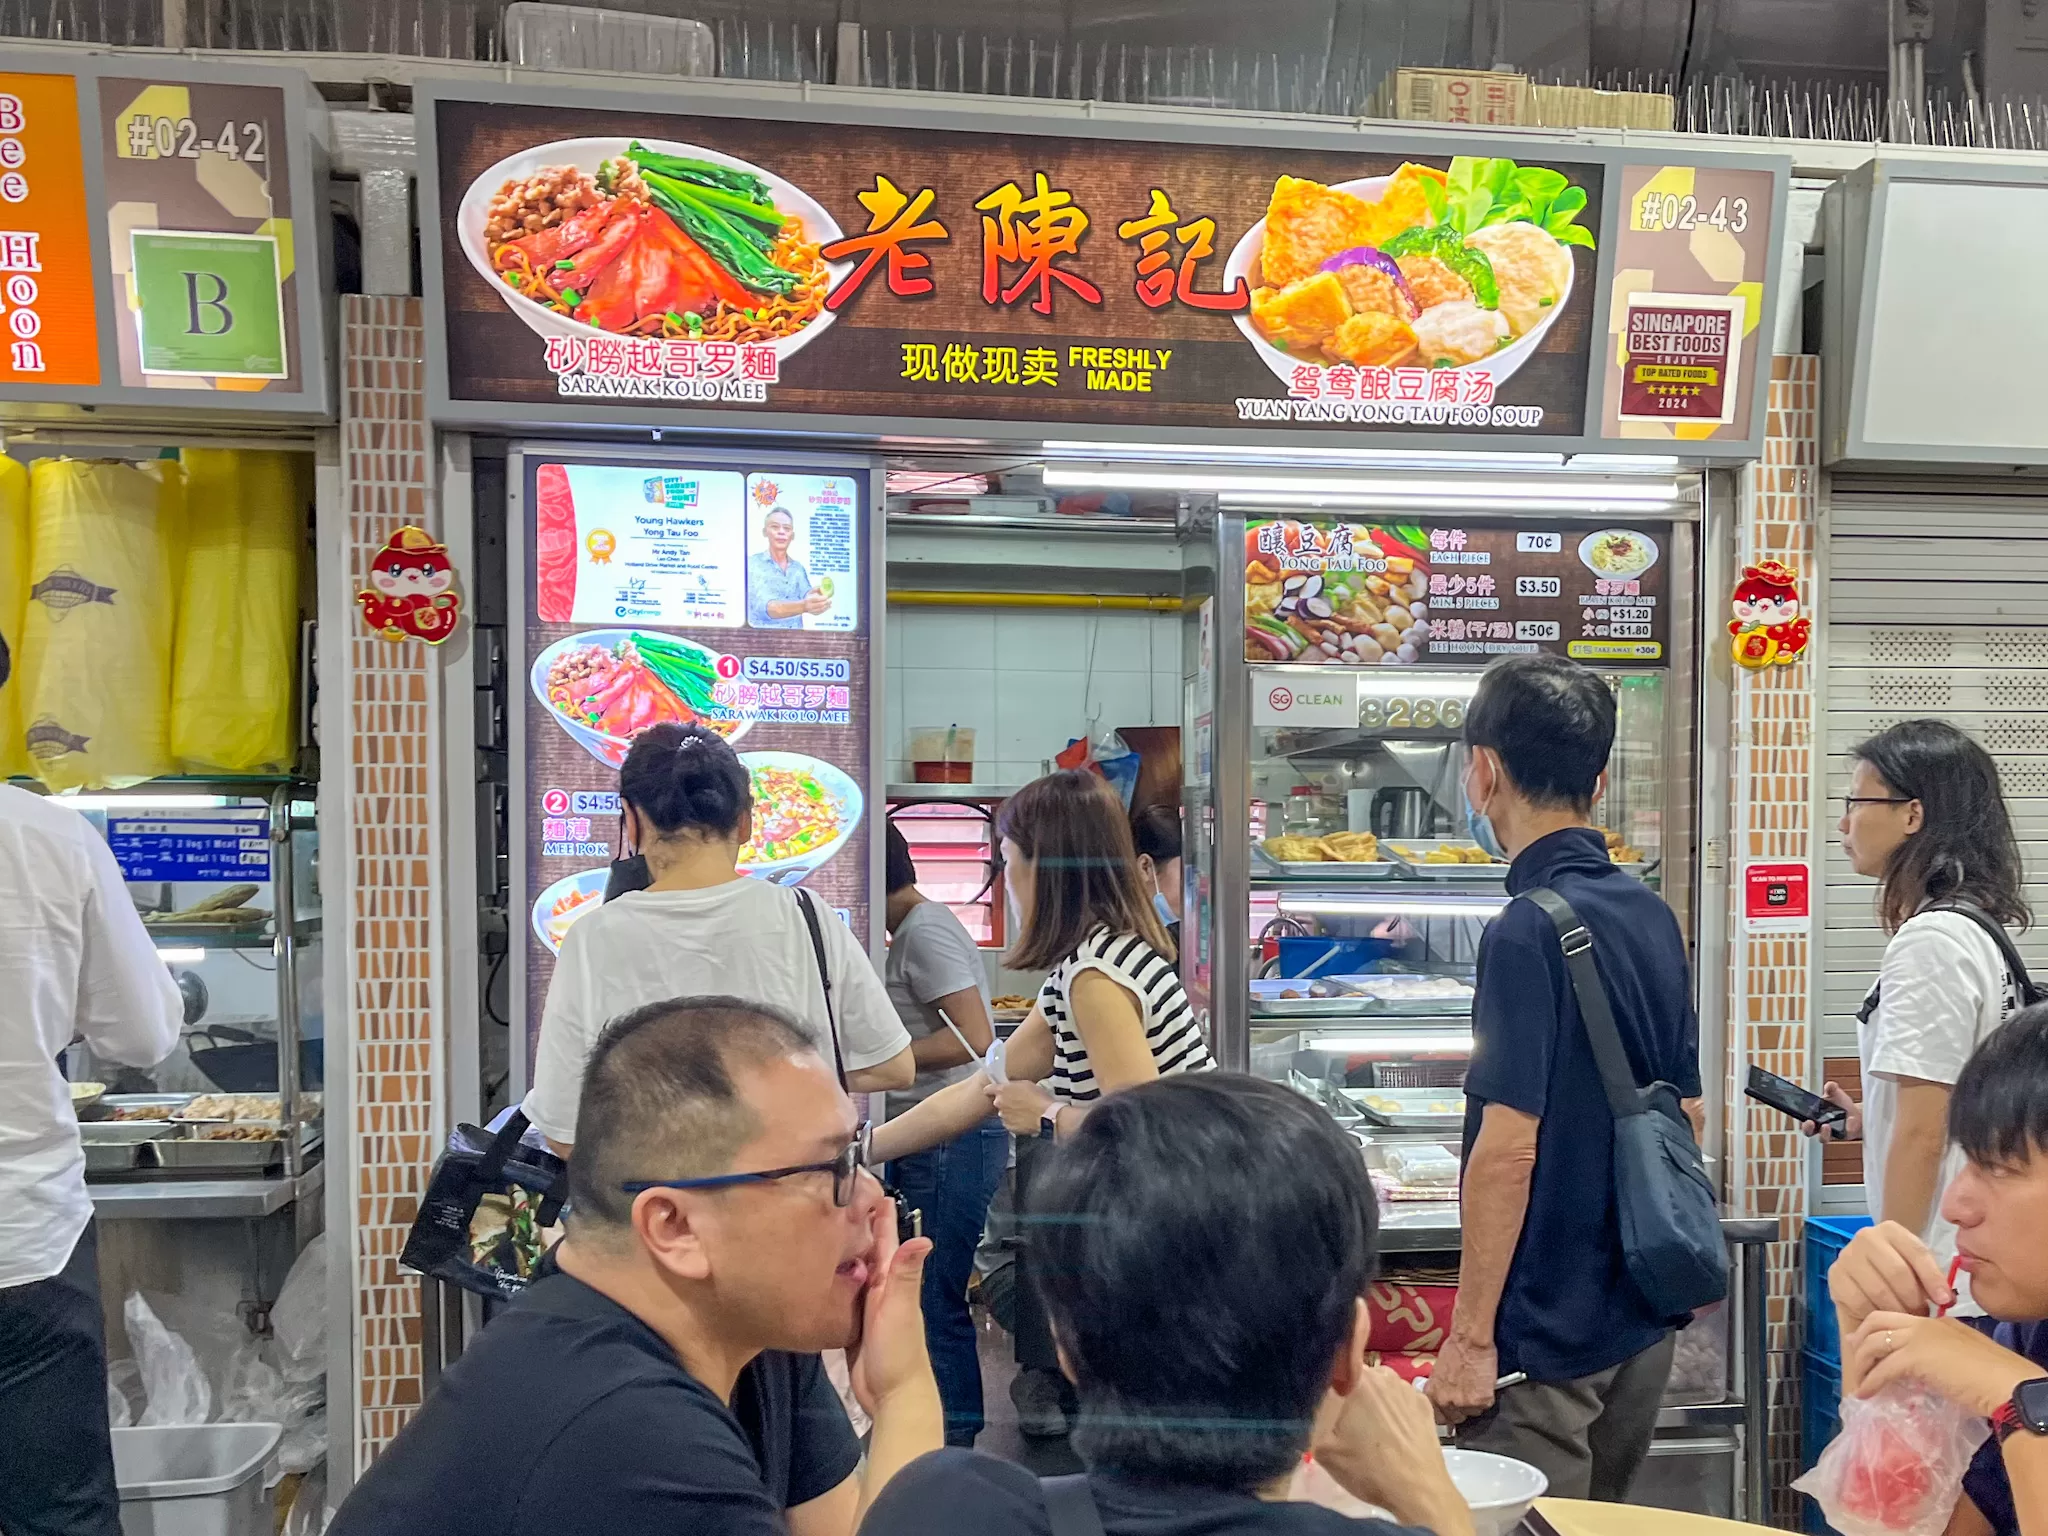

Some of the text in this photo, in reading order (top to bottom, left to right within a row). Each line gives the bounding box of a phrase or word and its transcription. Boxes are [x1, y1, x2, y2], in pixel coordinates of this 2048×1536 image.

[127, 114, 265, 161] #02-42
[1641, 192, 1749, 233] #02-43
[819, 172, 1250, 315] 老陳記
[182, 271, 234, 336] B
[1631, 312, 1727, 334] SINGAPORE
[1633, 334, 1721, 353] BEST FOODS
[901, 343, 1059, 387] 现做现卖
[1068, 345, 1172, 371] FRESHLY
[1656, 355, 1696, 365] ENJOY
[1086, 370, 1153, 392] MADE
[1642, 367, 1708, 378] TOP RATED FOODS
[560, 377, 764, 399] SARAWAK KOLO MEE
[1290, 364, 1494, 404] 鸳鸯酿豆腐汤
[1658, 398, 1688, 409] 2024
[1238, 401, 1542, 426] YUAN YANG YONG TAU FOO SOUP
[634, 515, 705, 526] Young Hawkers
[643, 528, 699, 537] Yong Tau Foo
[1430, 528, 1553, 551] 每件 70¢
[1279, 557, 1387, 571] YONG TAU FOO
[1431, 554, 1489, 563] EACH PIECE
[1429, 574, 1558, 596] 最少5件 $3.50
[1465, 598, 1499, 608] PIECES
[1612, 609, 1649, 620] +$1.20
[1520, 624, 1554, 638] +50¢
[1582, 623, 1596, 637] 大
[1612, 625, 1649, 636] +$1.80
[1430, 642, 1448, 652] BEE
[1450, 642, 1484, 652] HOON
[748, 659, 845, 678] $4.50/$5.50
[1272, 694, 1343, 705] SG CLEAN
[711, 708, 849, 723] SARAWAK KOLO MEE
[545, 843, 607, 855] MEE POK
